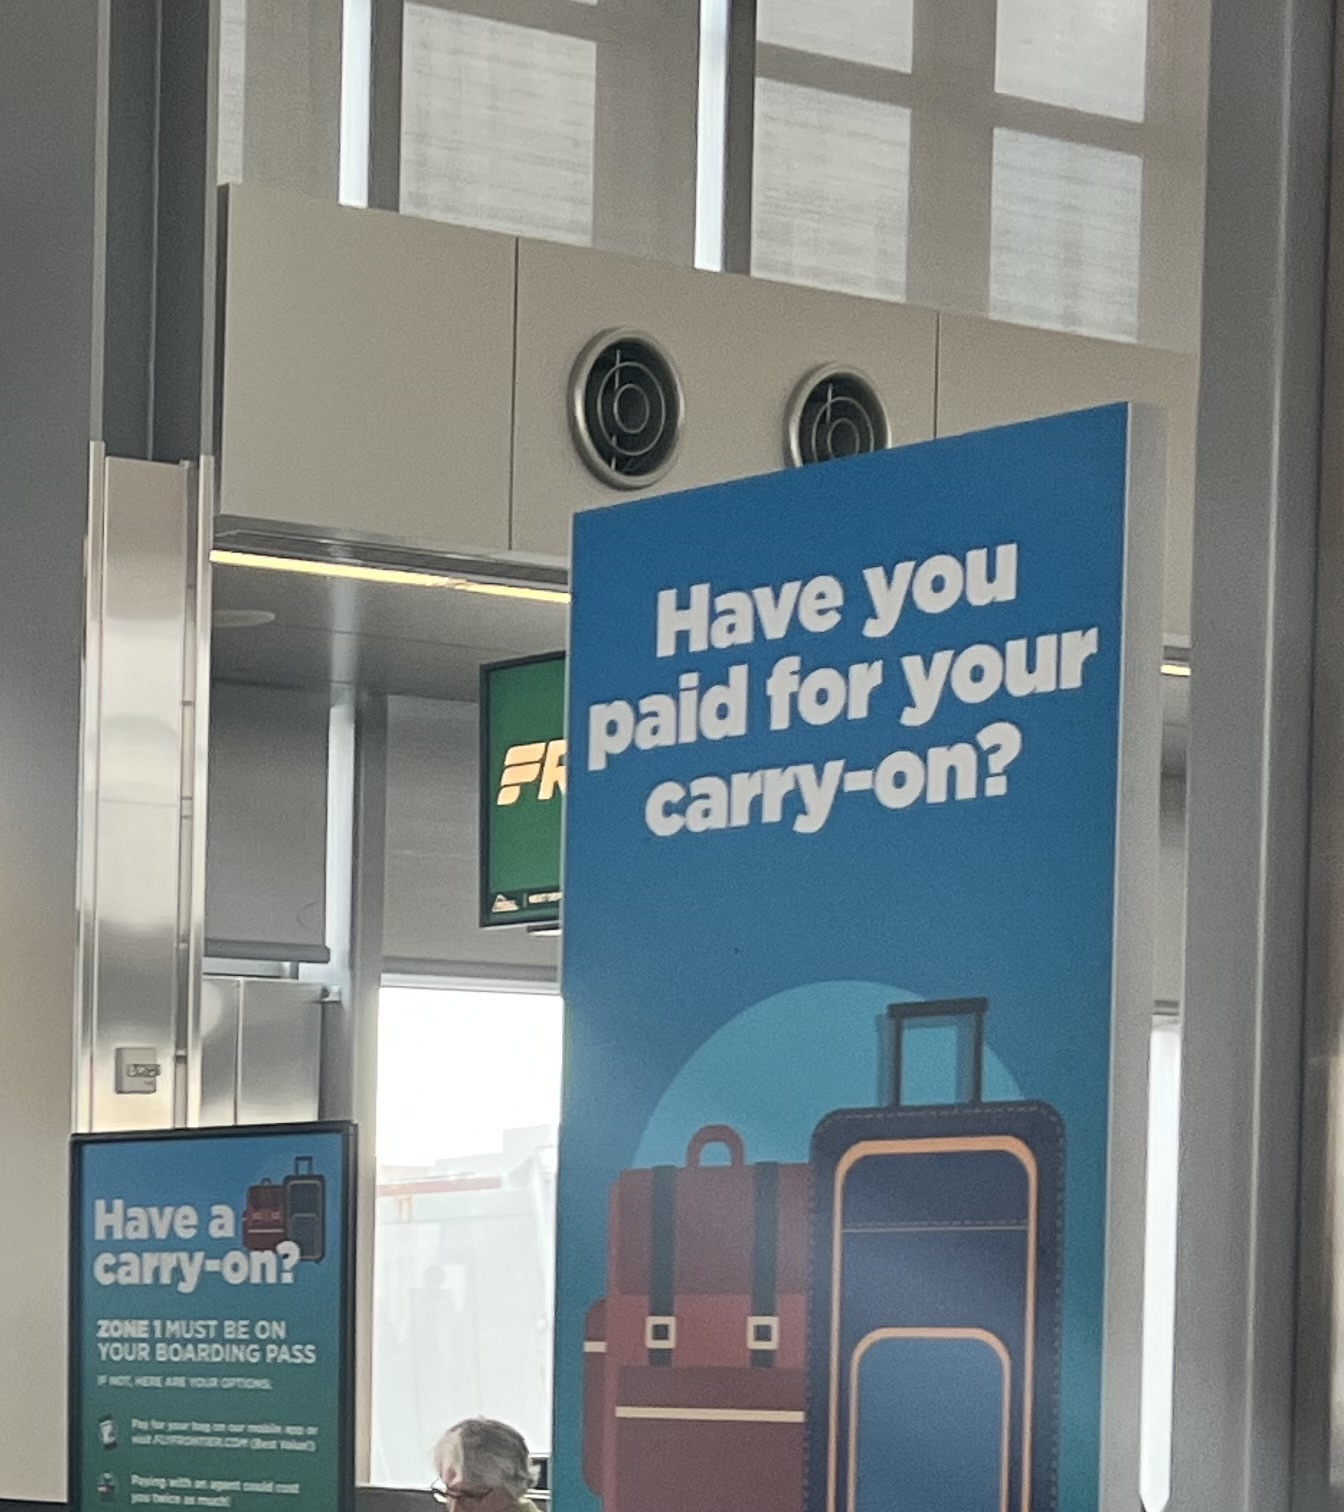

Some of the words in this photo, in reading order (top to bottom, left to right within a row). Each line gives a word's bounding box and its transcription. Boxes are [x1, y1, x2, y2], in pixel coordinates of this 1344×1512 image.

[655, 575, 843, 658] Have
[862, 542, 1018, 639] you
[587, 666, 748, 771] paid
[766, 655, 883, 732] for
[900, 627, 1098, 727] your
[644, 721, 1023, 838] carry-on?
[94, 1198, 200, 1242] Have
[208, 1203, 236, 1239] a
[93, 1240, 301, 1294] carry-on?
[96, 1319, 150, 1339] ZONE
[153, 1319, 162, 1339] 1
[165, 1320, 218, 1340] MUST
[223, 1319, 251, 1340] BE
[254, 1320, 287, 1340] ON
[96, 1342, 150, 1362] YOUR
[155, 1342, 261, 1364] BOARDING
[266, 1344, 317, 1365] PASS
[97, 1375, 107, 1386] IF
[135, 1376, 163, 1388] HERE
[165, 1376, 187, 1388] ARE
[189, 1377, 219, 1389] YOUR
[167, 1421, 190, 1432] your
[130, 1473, 167, 1490] Paying
[168, 1477, 192, 1489] with
[210, 1480, 241, 1492] agent
